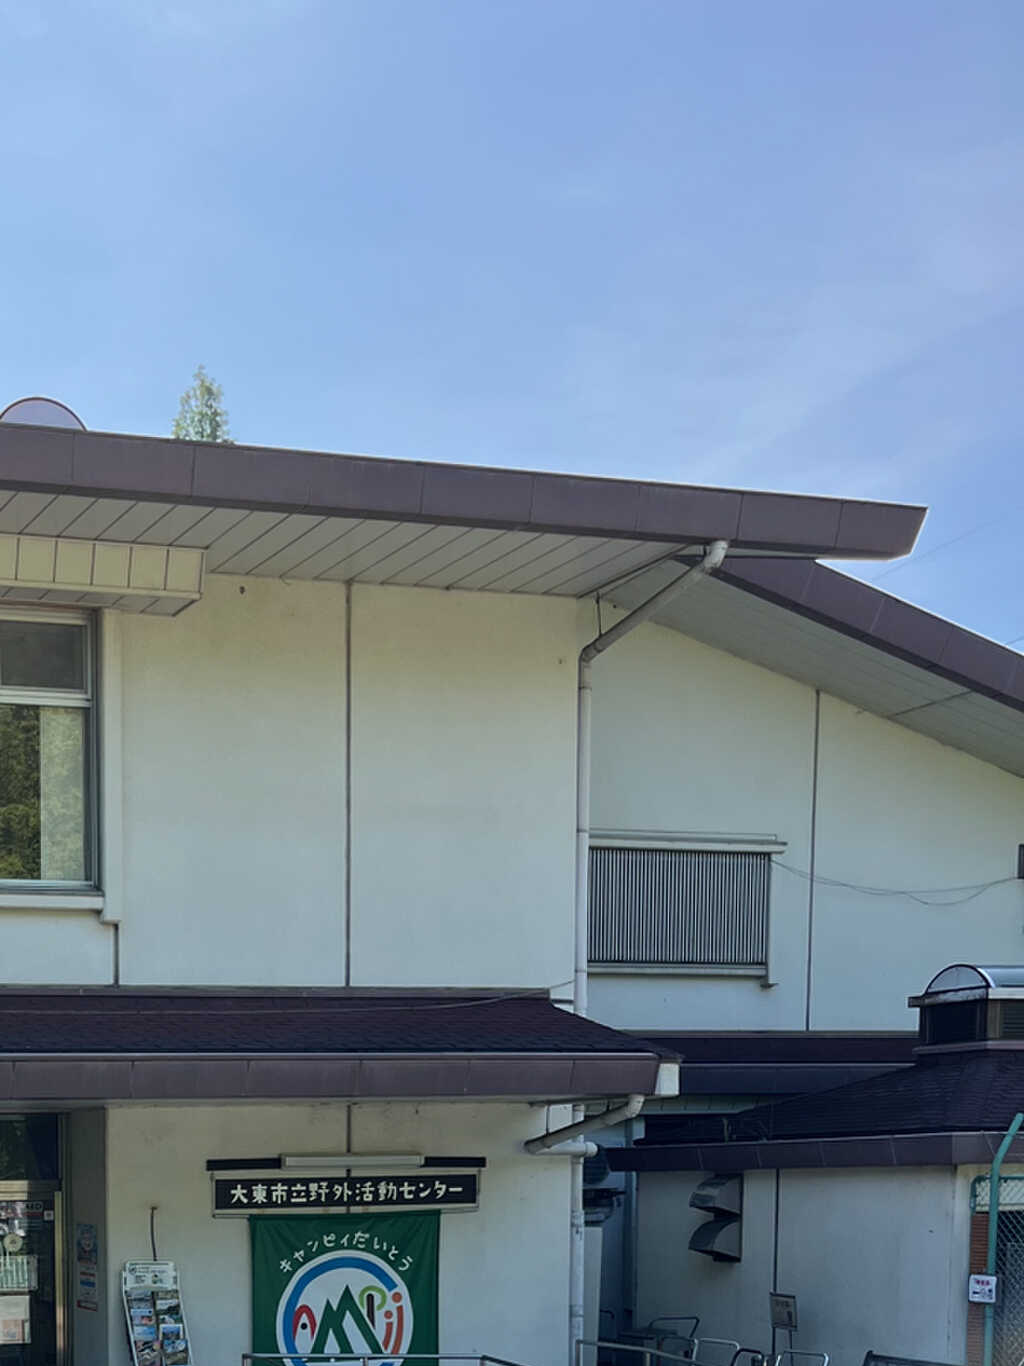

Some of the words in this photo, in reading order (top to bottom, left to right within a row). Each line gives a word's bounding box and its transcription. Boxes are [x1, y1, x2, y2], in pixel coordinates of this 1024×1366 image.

[230, 1180, 464, 1204] 大東市立野外活動センター
